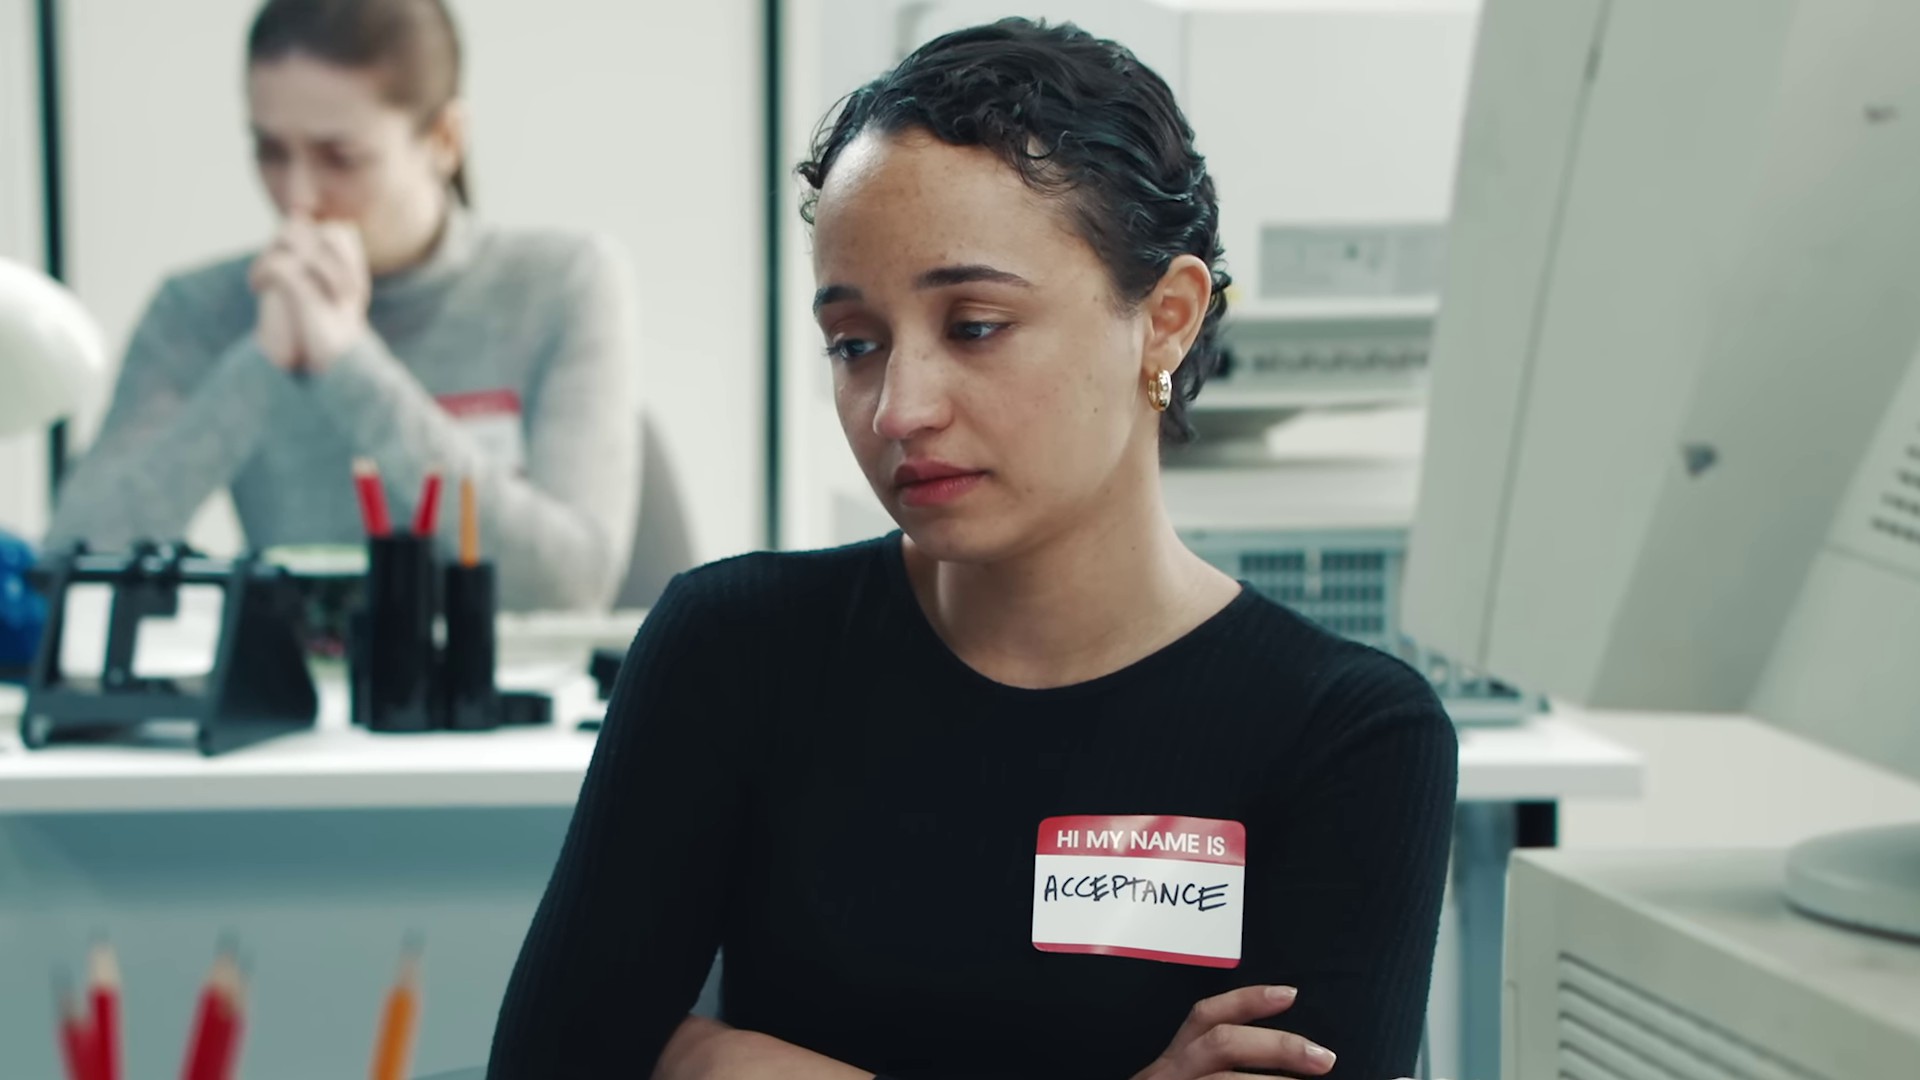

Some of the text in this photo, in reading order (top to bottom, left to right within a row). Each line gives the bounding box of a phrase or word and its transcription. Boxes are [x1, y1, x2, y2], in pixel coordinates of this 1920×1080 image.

[1057, 830, 1225, 856] HI MY NAME IS
[1044, 874, 1229, 912] ACCEPTANCE
